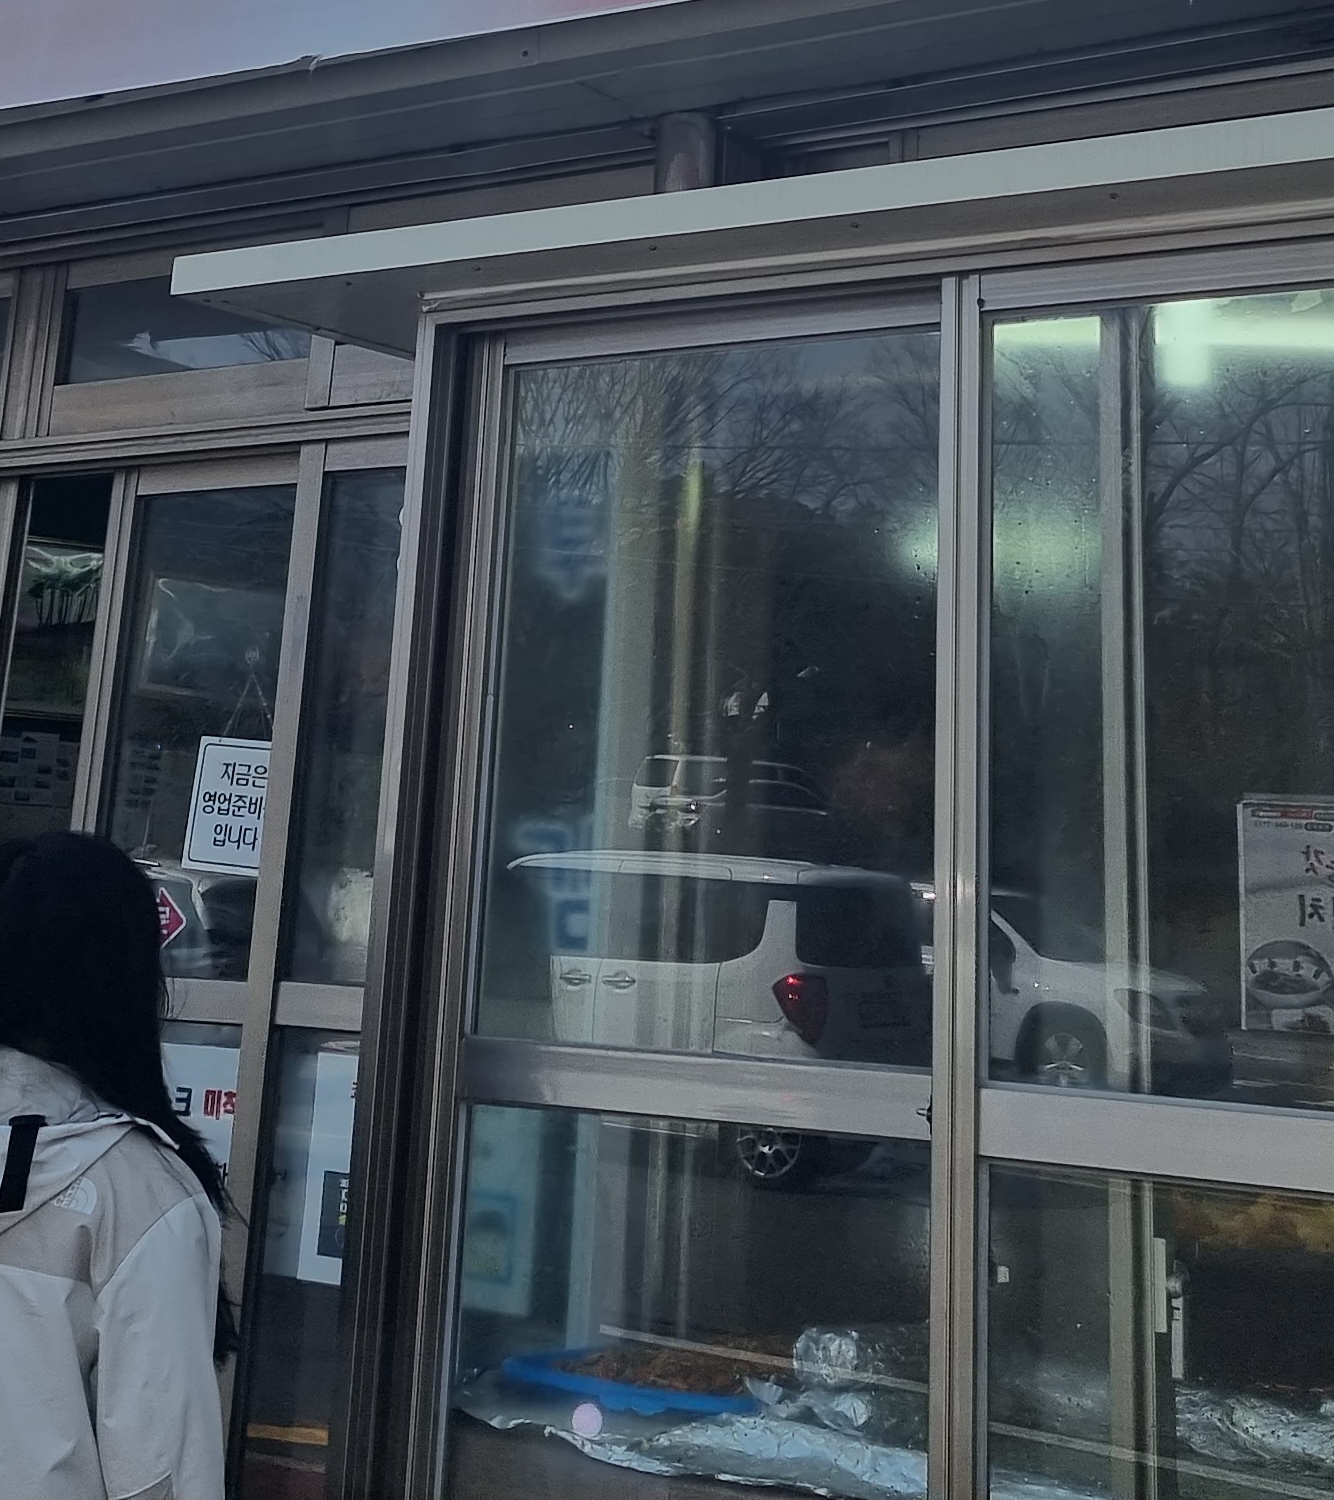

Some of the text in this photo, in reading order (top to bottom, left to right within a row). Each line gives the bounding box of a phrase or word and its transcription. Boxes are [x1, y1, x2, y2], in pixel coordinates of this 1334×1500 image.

[219, 761, 269, 789] 지금은
[202, 790, 266, 821] 영업준비
[212, 823, 259, 852] 입니다
